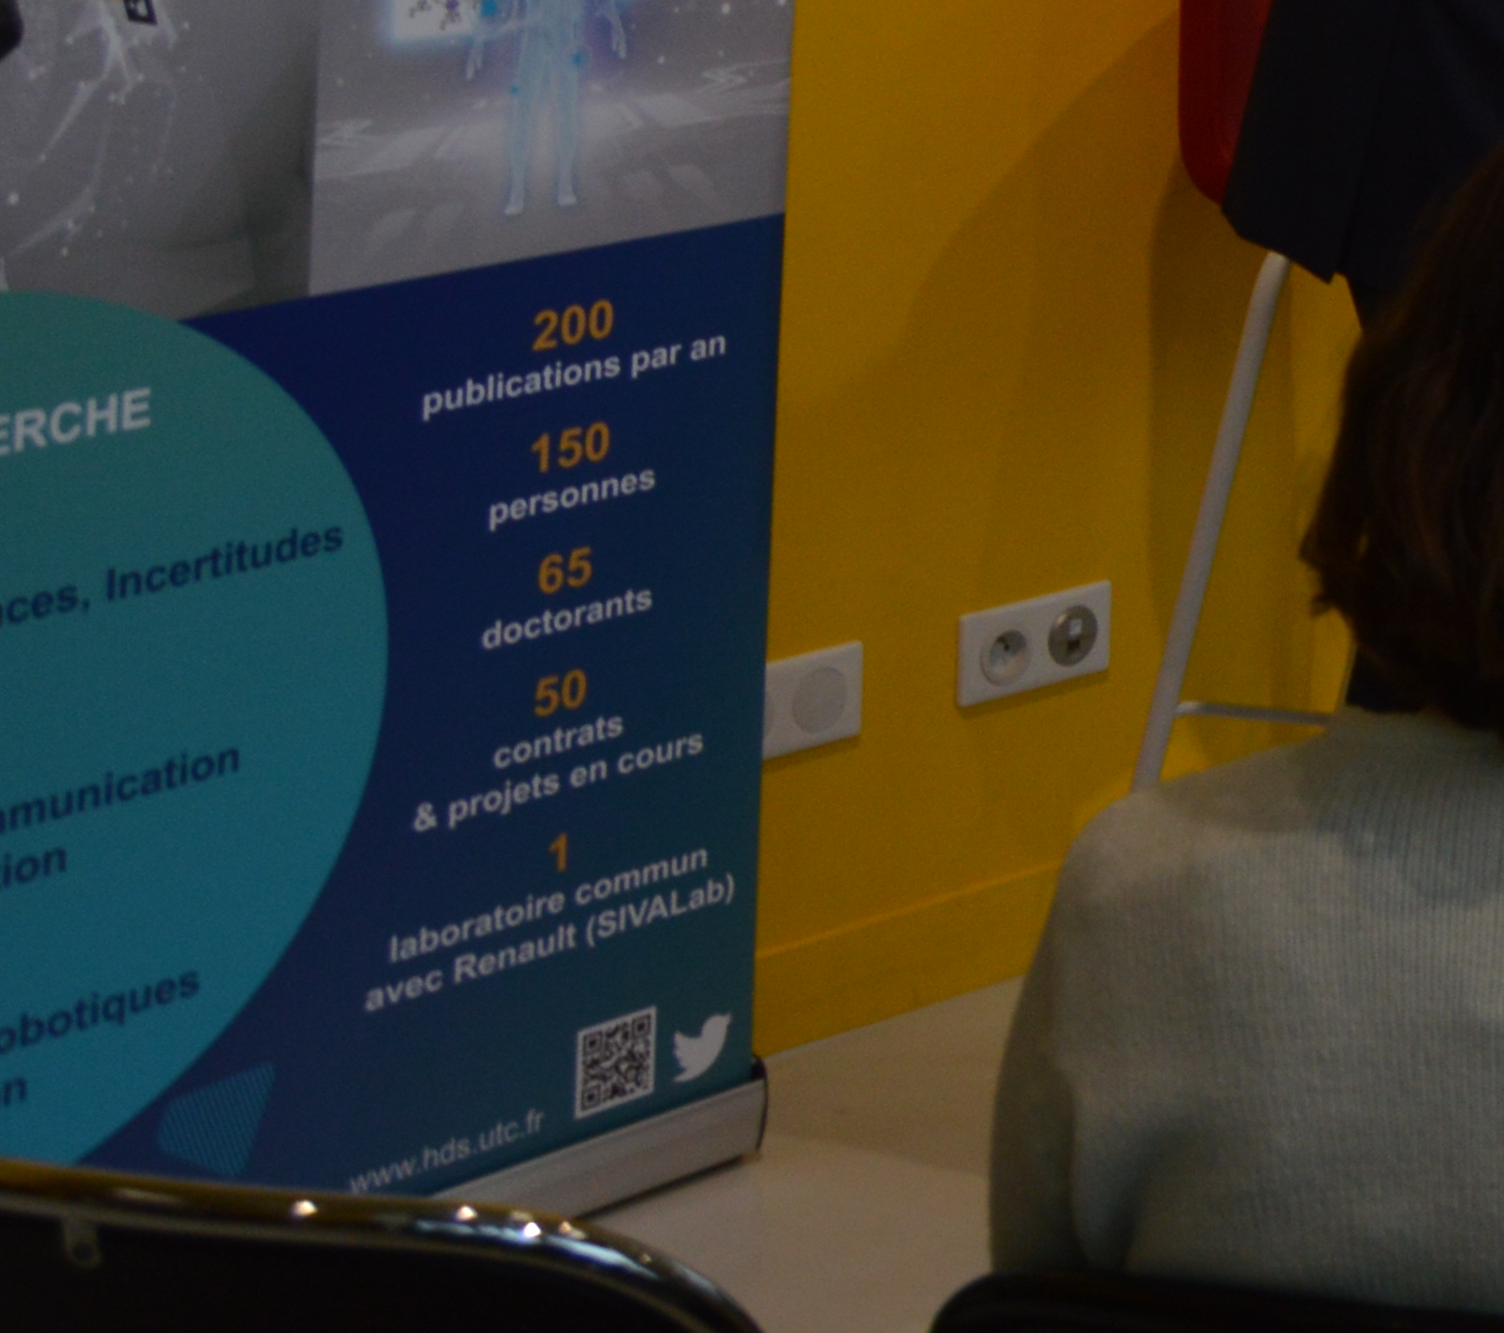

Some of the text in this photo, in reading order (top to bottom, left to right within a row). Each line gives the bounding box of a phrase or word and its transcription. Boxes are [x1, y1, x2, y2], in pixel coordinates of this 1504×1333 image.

[531, 298, 614, 352] 200
[421, 334, 727, 421] publications par an
[530, 421, 611, 473] 150
[488, 468, 657, 533] personnes
[0, 526, 344, 627] ces, Incertitudes
[537, 546, 593, 595] 65
[481, 587, 653, 650] doctorants
[533, 668, 587, 718] 50
[493, 714, 625, 770] contrats
[0, 747, 241, 832] munication
[412, 732, 704, 832] & projets en cours
[547, 832, 569, 872] 1
[388, 846, 708, 963] laboratoire commun
[364, 873, 735, 1013] avec Renault (SIVALab)
[349, 1107, 545, 1193] www.hds.utc.fr
